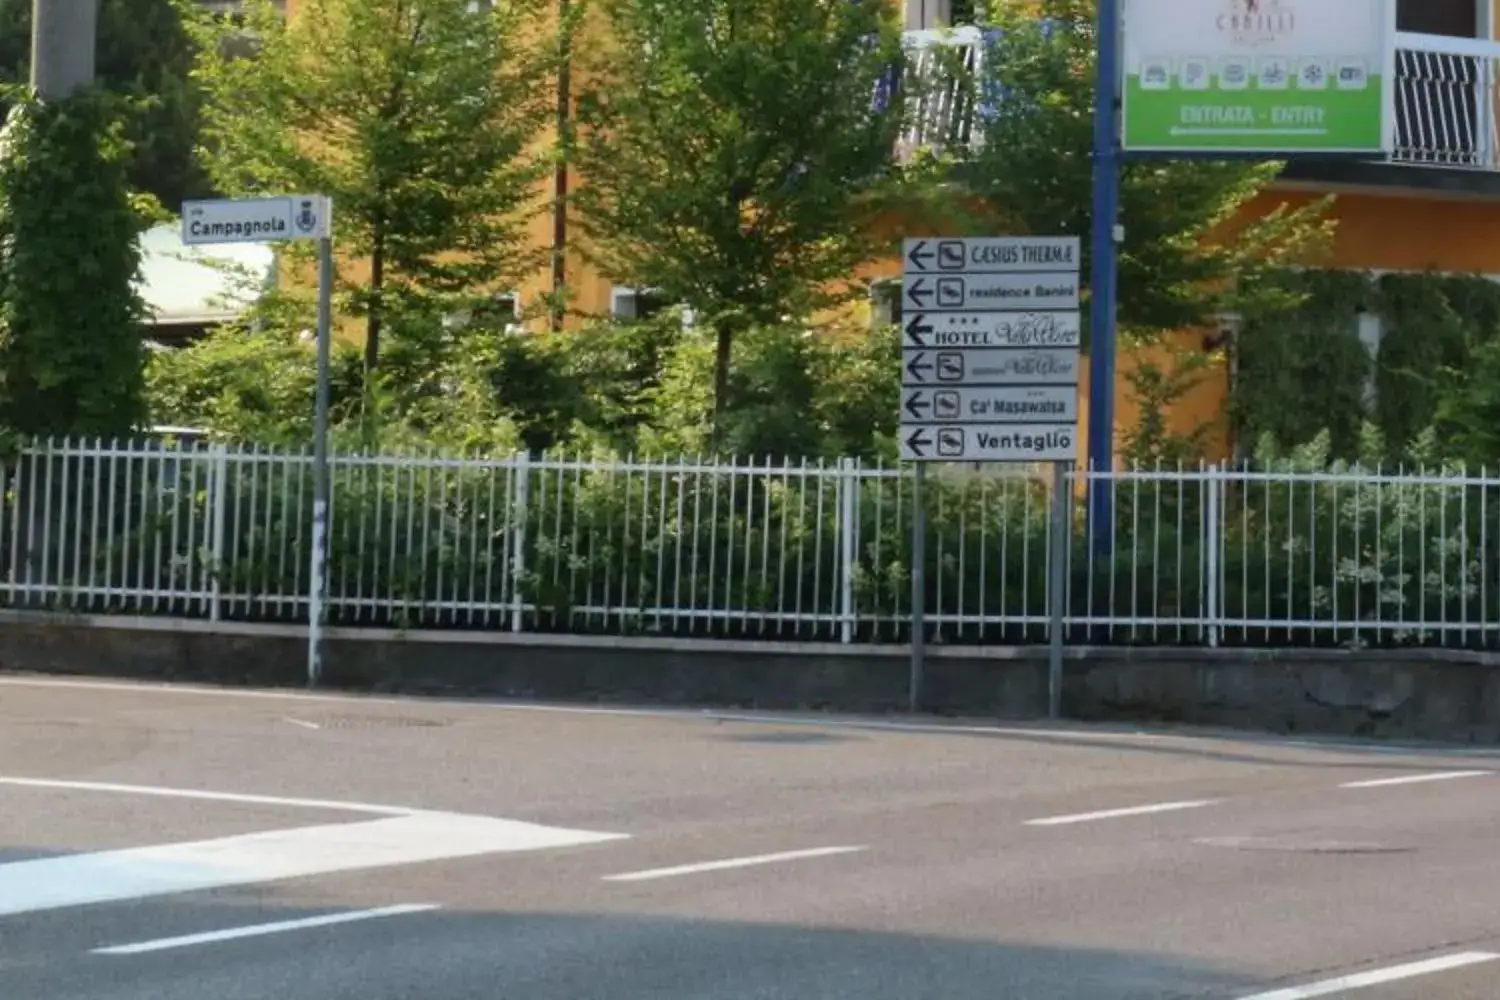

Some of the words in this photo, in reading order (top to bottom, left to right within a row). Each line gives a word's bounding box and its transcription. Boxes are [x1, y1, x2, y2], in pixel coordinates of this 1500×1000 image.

[1180, 105, 1254, 123] ENTRATA
[1271, 105, 1326, 123] ENTRY
[190, 216, 285, 237] Campagnola
[935, 331, 993, 344] HOTEL
[977, 431, 1071, 452] Ventaglio
